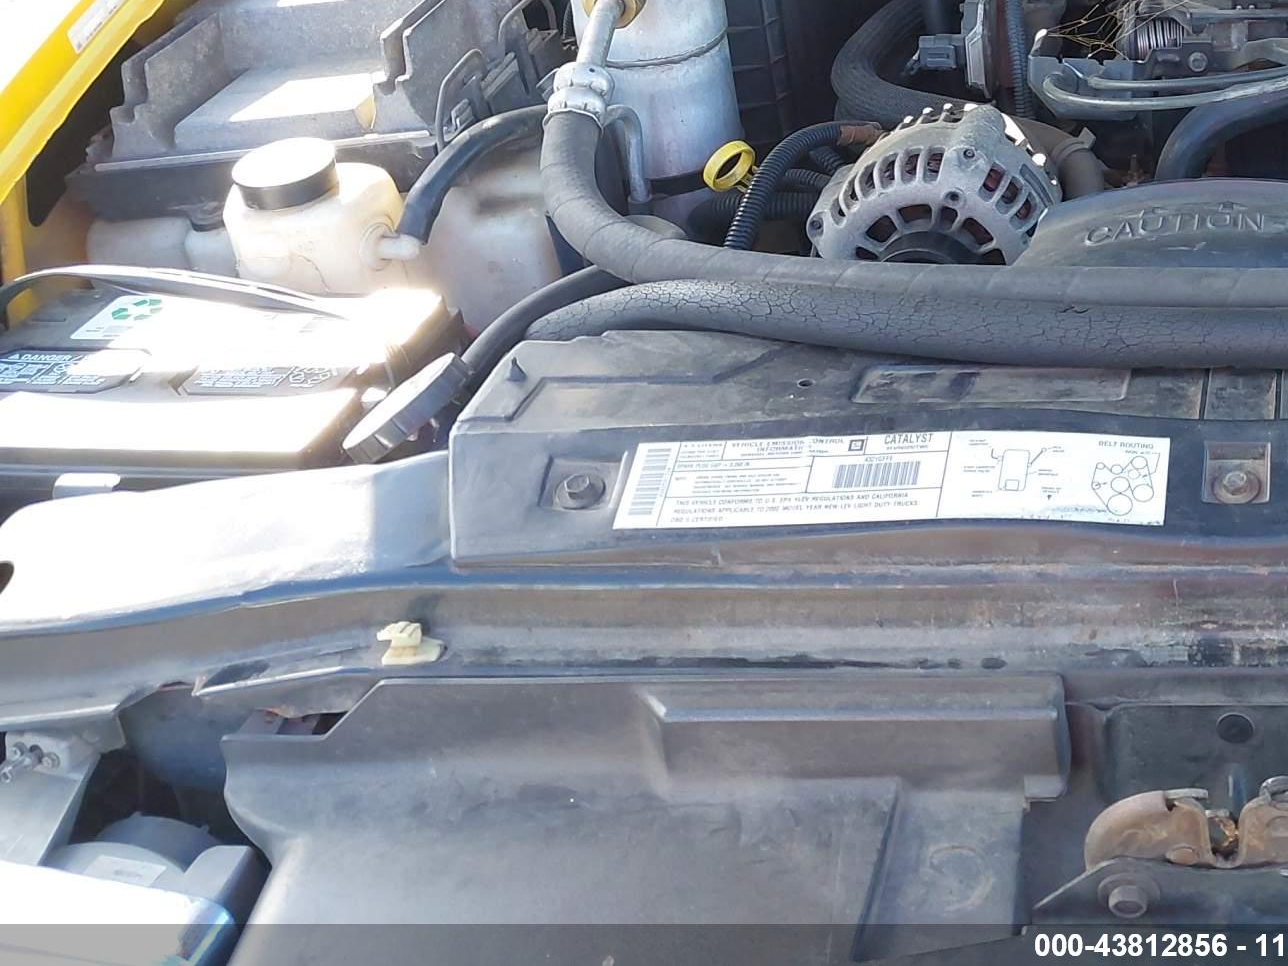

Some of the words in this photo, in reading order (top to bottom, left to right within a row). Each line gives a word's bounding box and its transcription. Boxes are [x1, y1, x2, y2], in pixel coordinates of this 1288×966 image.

[1084, 208, 1265, 247] CAUTION
[809, 437, 845, 445] ONTROL
[884, 433, 934, 445] CATALYST
[1119, 441, 1154, 451] ROUTING
